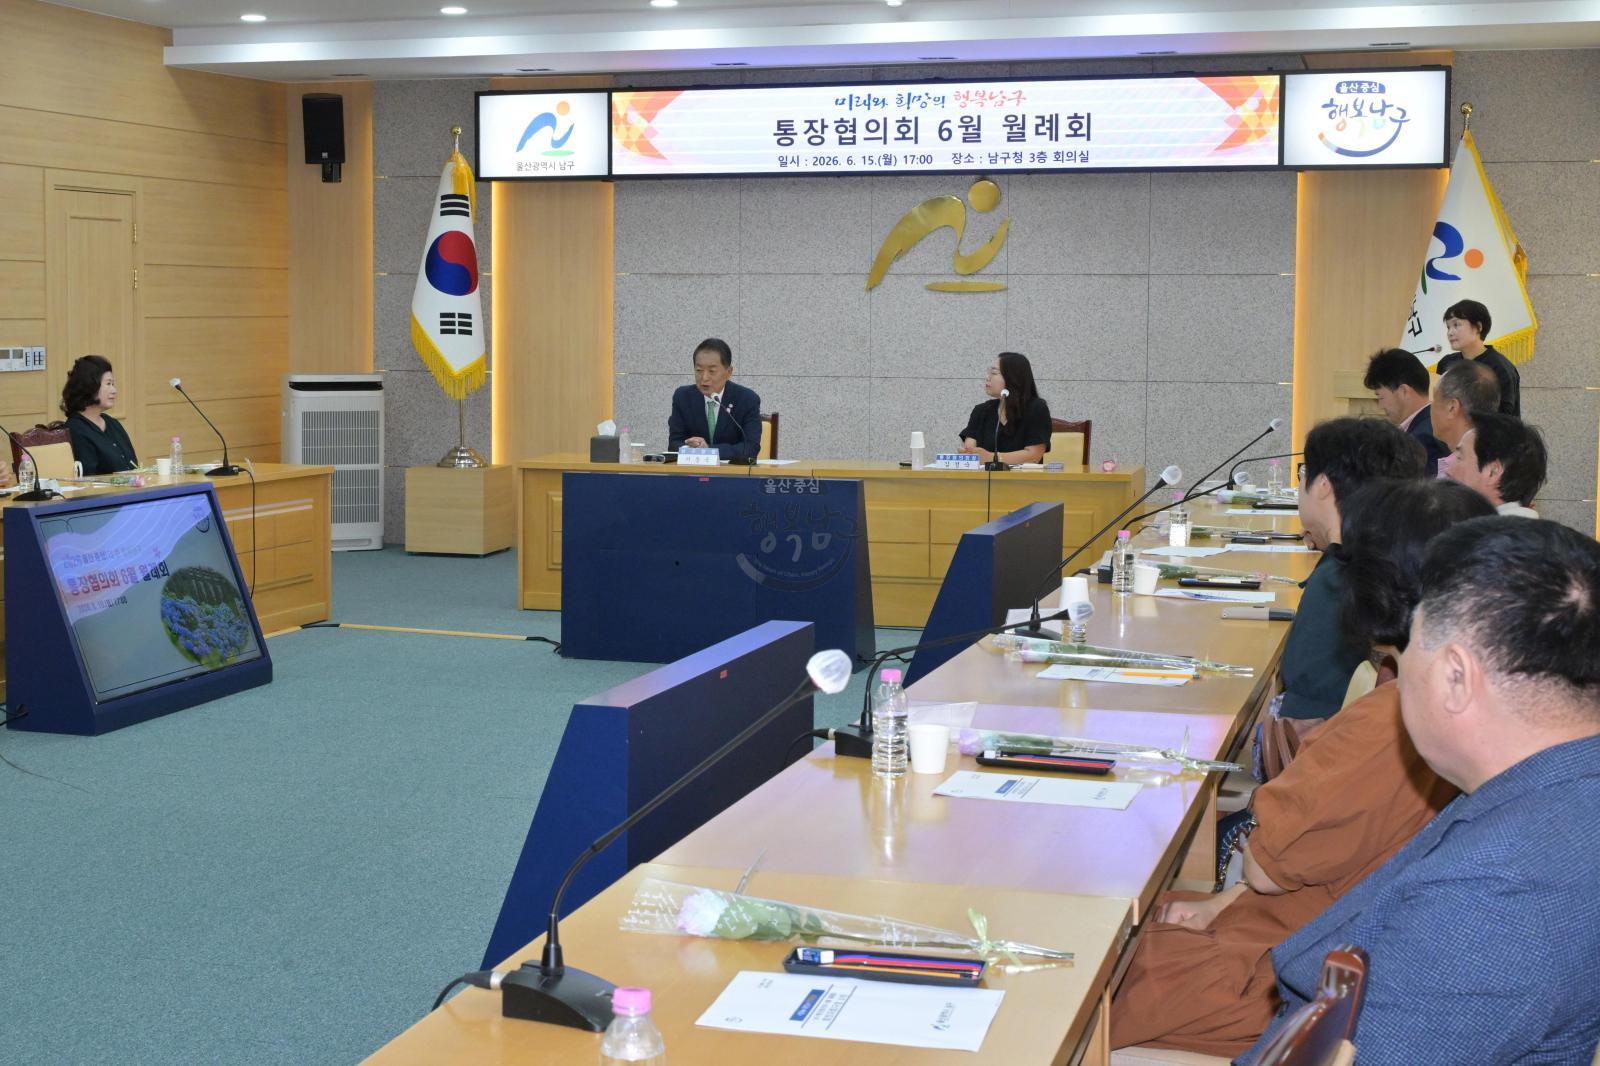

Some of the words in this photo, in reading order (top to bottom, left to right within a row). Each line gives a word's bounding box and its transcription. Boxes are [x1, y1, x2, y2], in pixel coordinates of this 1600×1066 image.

[834, 93, 888, 111] 미래와
[895, 92, 946, 110] 희망의
[953, 89, 1028, 108] 행복남구
[773, 116, 919, 147] 통장협의회
[938, 114, 982, 144] 6월
[1002, 112, 1092, 143] 월례회
[1320, 97, 1412, 139] 행복남구
[515, 161, 556, 172] 울산광역시
[559, 160, 576, 172] 남구
[778, 155, 800, 168] 일시
[812, 156, 842, 166] 2026.
[846, 155, 857, 166] 6.
[862, 153, 898, 167] 15.(월)
[903, 154, 933, 165] 17:00
[951, 152, 975, 165] 장소
[988, 151, 1023, 165] 남구청
[1029, 151, 1048, 164] 3층
[1052, 150, 1090, 164] 회의실
[68, 572, 121, 596] 통장협의회
